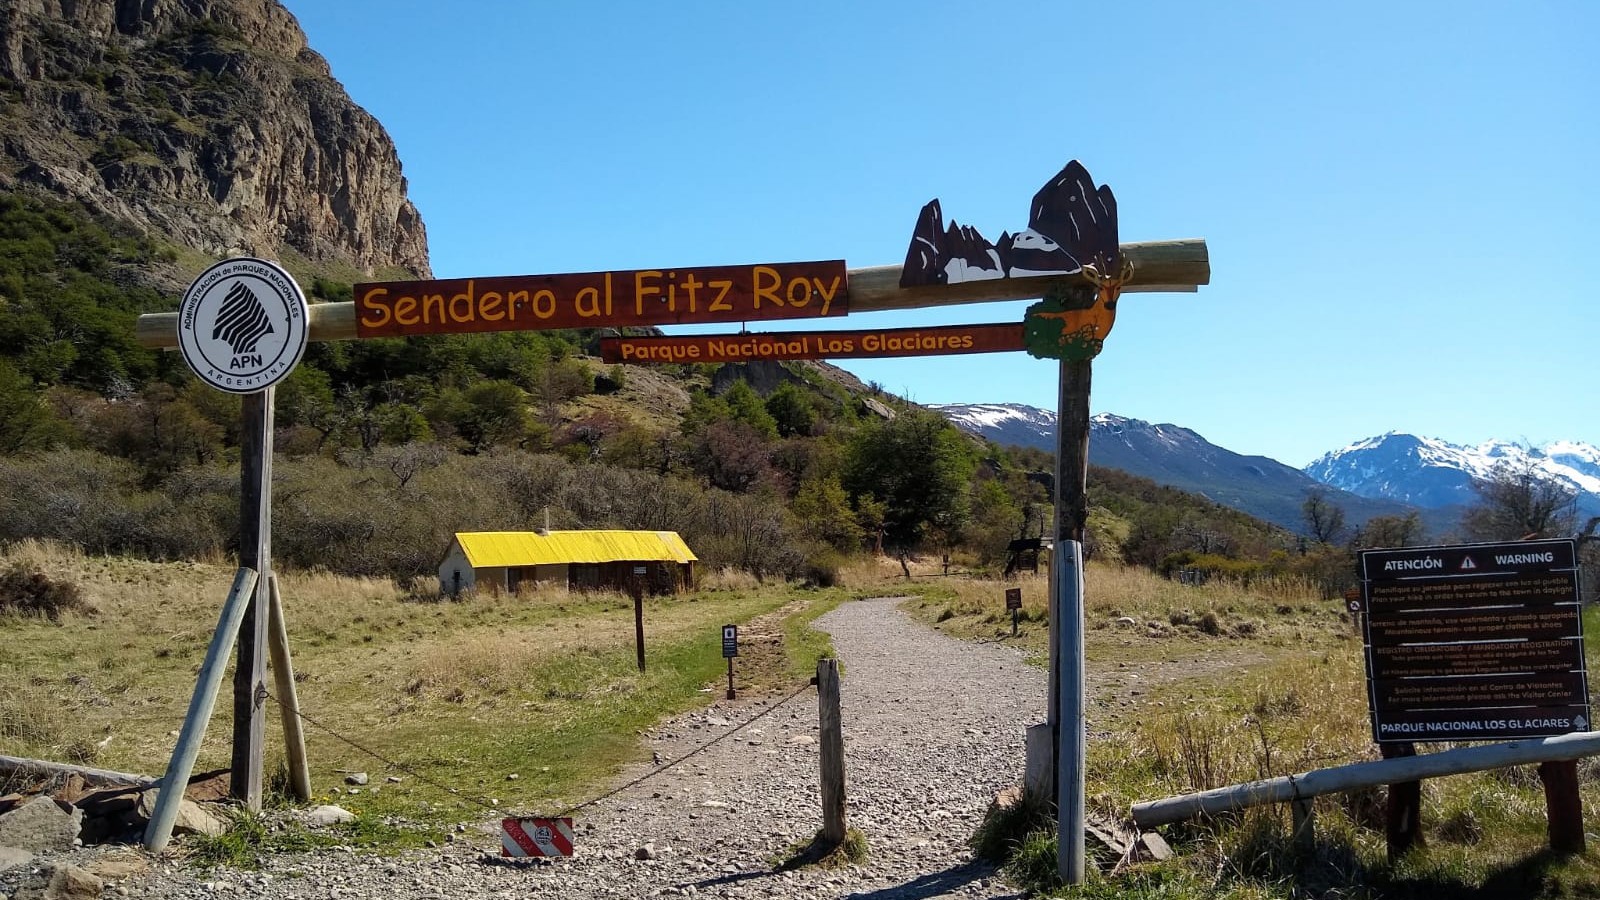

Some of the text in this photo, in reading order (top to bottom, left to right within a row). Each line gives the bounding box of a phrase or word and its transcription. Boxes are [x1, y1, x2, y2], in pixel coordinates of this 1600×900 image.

[185, 272, 220, 330] ADMINISTRACIÓN
[233, 265, 268, 276] PARQUES
[270, 274, 299, 318] NACIONALES
[362, 266, 840, 328] Sendero al Fitz Roy
[622, 333, 974, 362] Parque Nacional Los Glaciares
[230, 355, 262, 369] APN
[208, 361, 286, 386] ARGENTINA
[1384, 552, 1554, 571] ATENCIÓN WARNING
[1472, 642, 1520, 650] MANDATORY
[1520, 640, 1573, 648] REGISTRATION
[1521, 690, 1545, 699] Visitor
[1546, 690, 1572, 698] Center
[1381, 718, 1570, 733] PARQUE NACIONAL LOS GLACIARES
